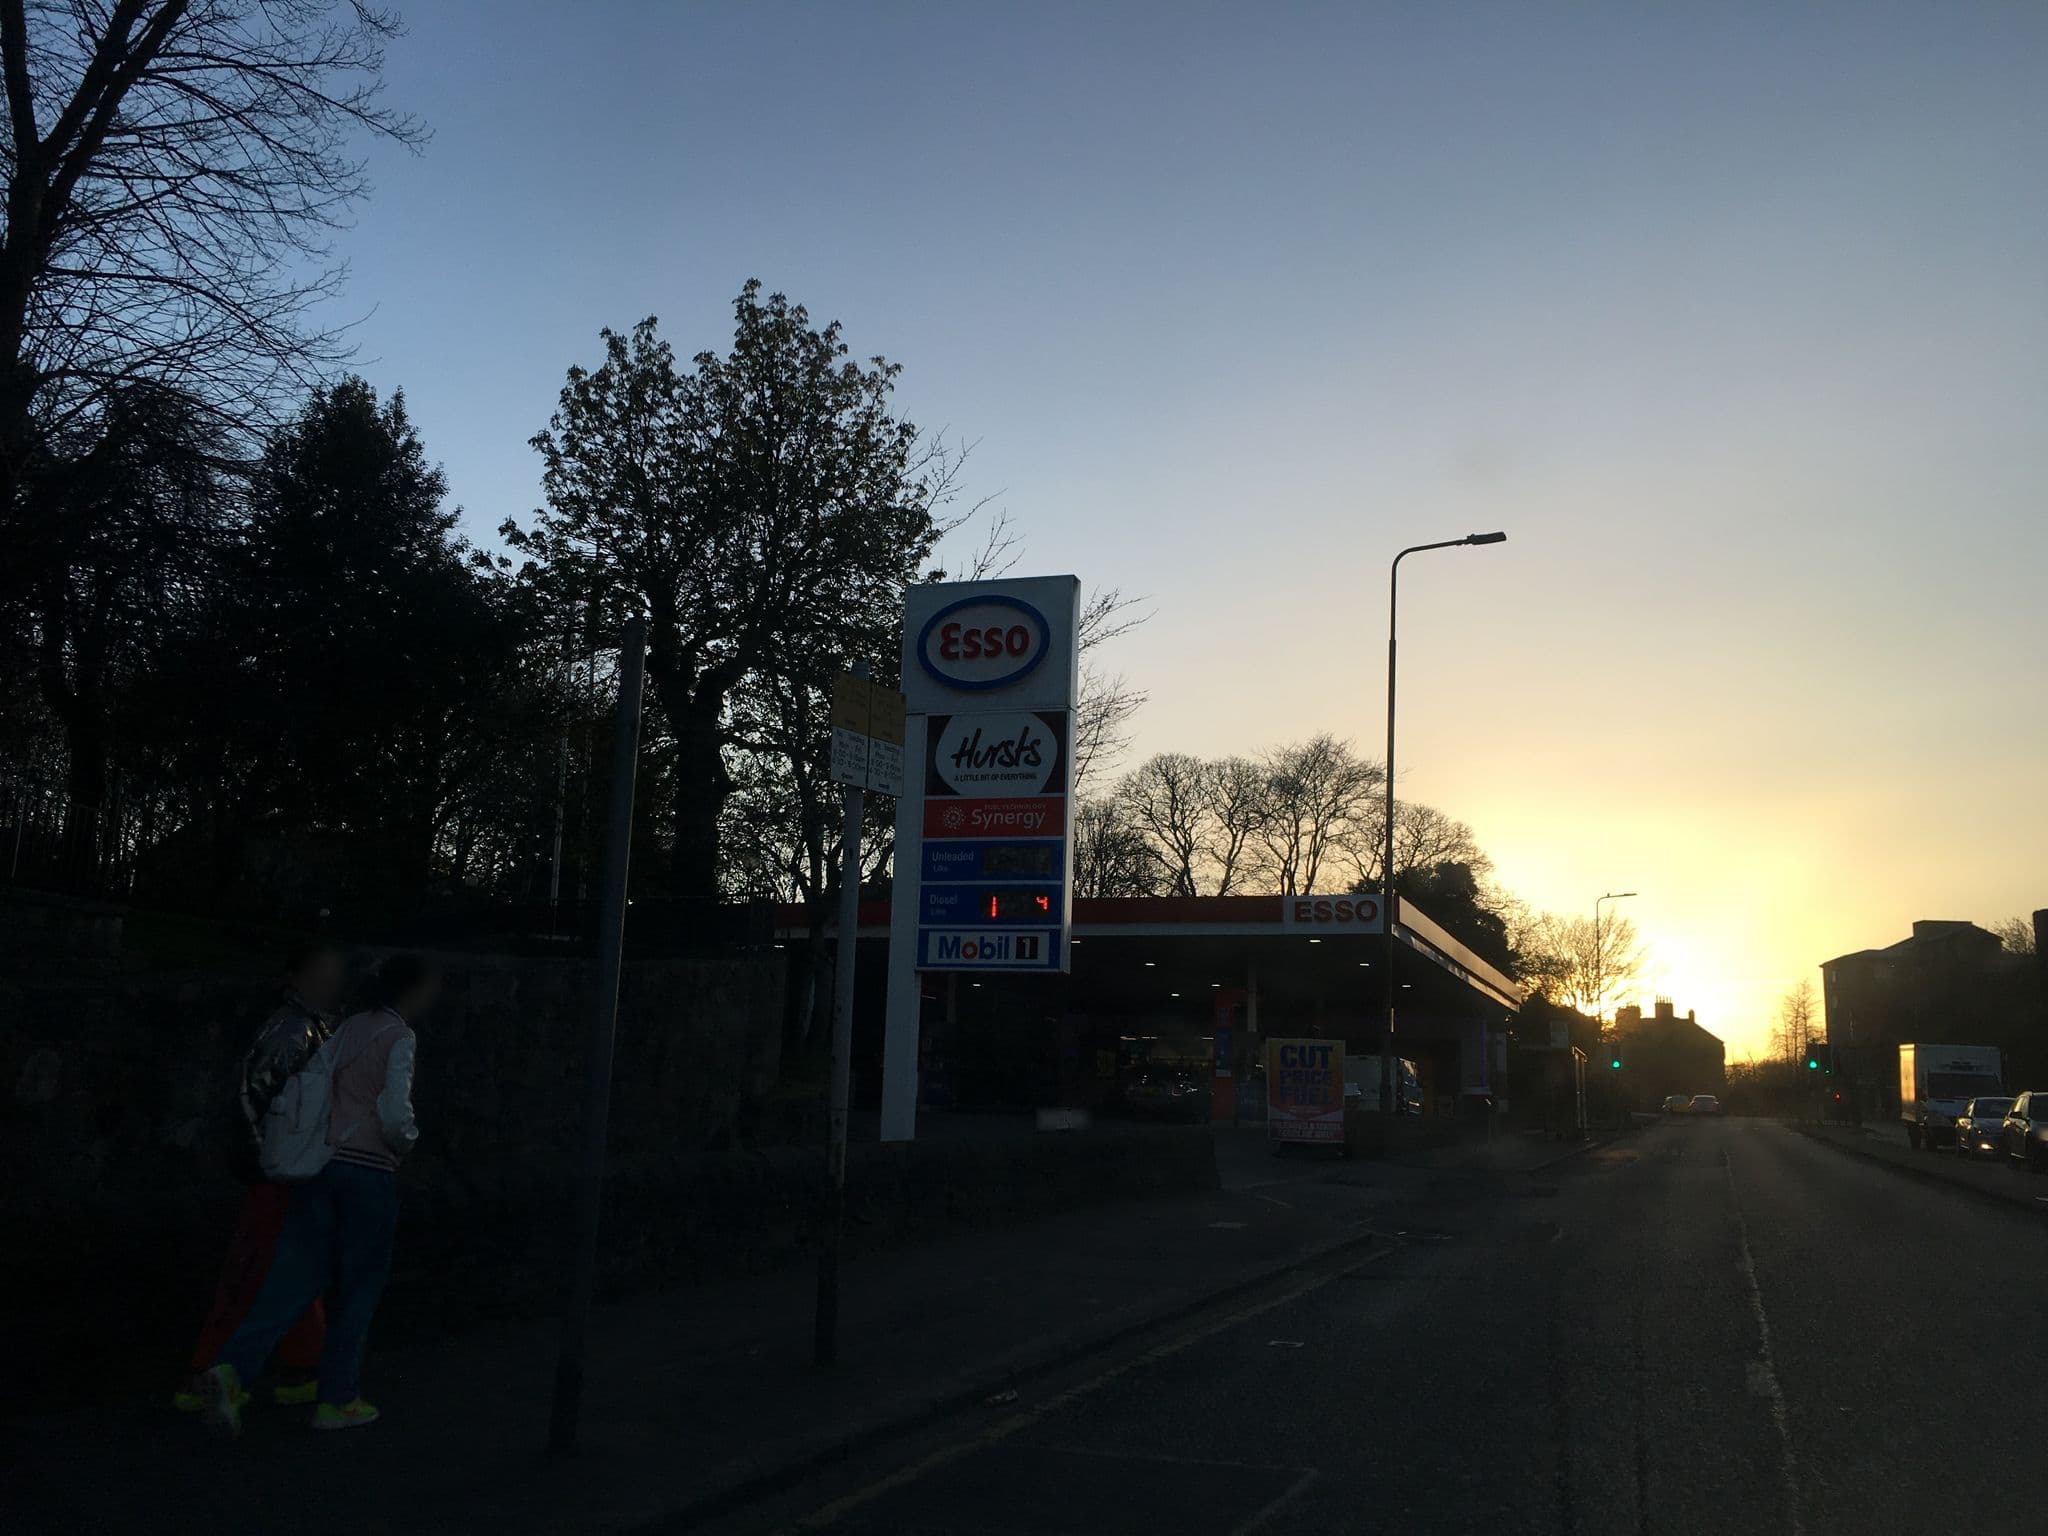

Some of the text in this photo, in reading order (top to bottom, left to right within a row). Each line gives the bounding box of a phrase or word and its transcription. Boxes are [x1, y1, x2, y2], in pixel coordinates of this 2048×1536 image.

[971, 808, 1046, 832] Synergy
[932, 850, 975, 862] Unleaded
[930, 894, 958, 905] Diesel
[1294, 900, 1377, 922] ESSO
[938, 935, 1035, 959] Mobil 1
[1280, 1045, 1333, 1068] CUT
